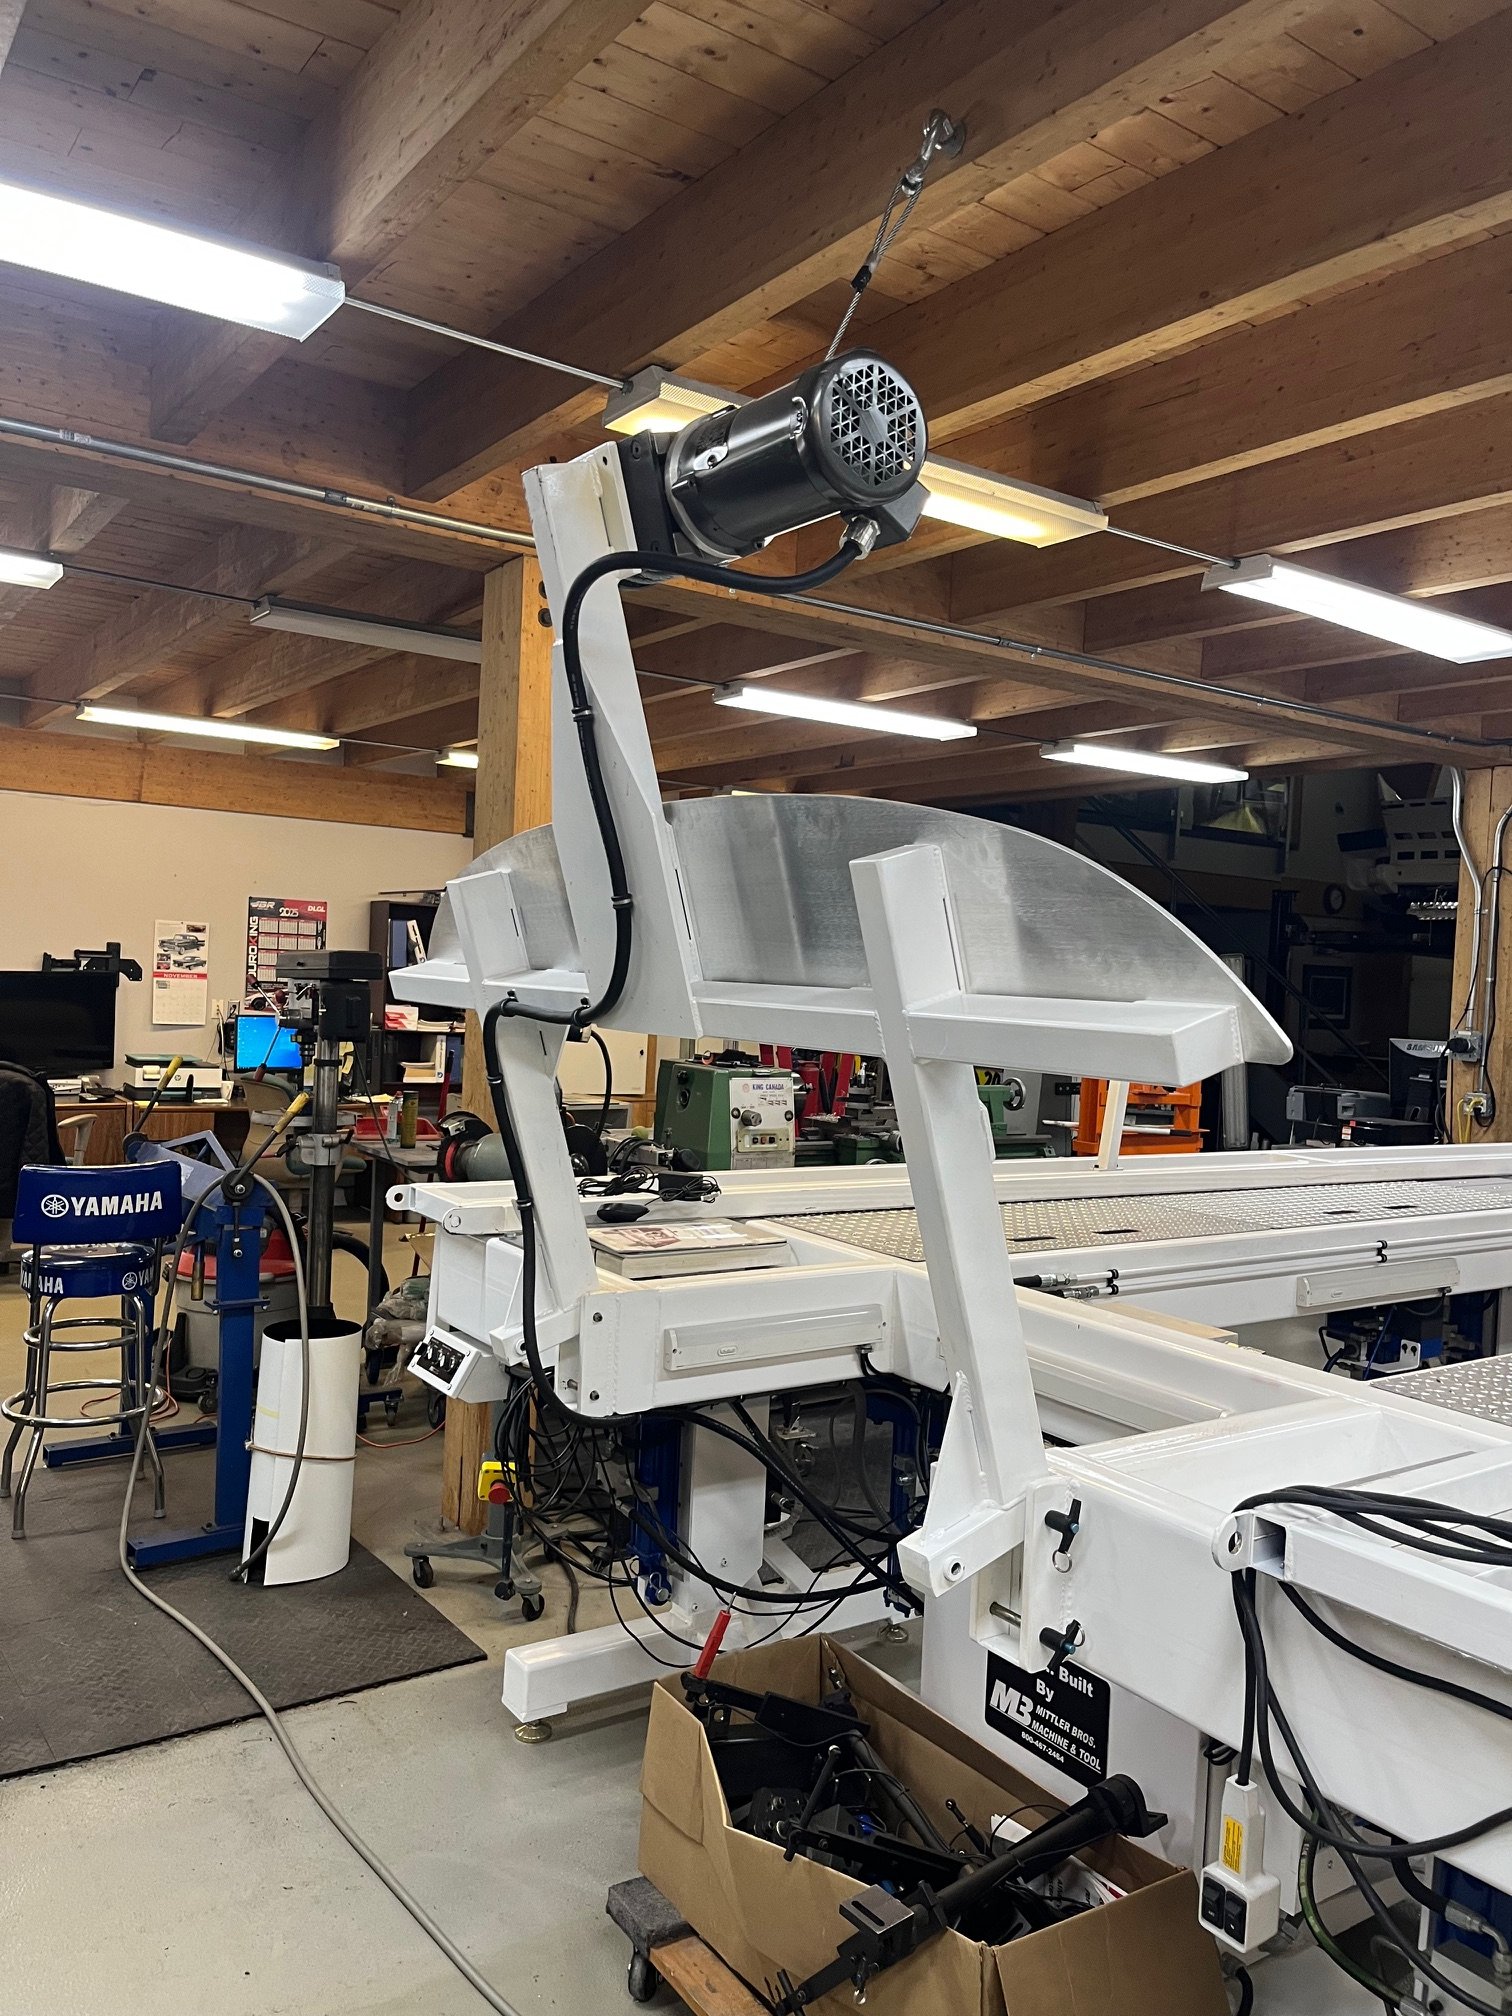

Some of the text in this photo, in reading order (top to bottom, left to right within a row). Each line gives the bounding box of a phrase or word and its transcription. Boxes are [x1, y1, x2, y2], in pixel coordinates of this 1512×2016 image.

[279, 907, 299, 917] 2025
[752, 1083, 785, 1091] KING CANADA
[70, 1190, 164, 1217] YAMAHA
[1036, 1678, 1055, 1703] By
[1059, 1665, 1094, 1698] Built
[1035, 1704, 1096, 1749] MITTLER BROS.
[1031, 1719, 1101, 1771] MACHINE & TOOL
